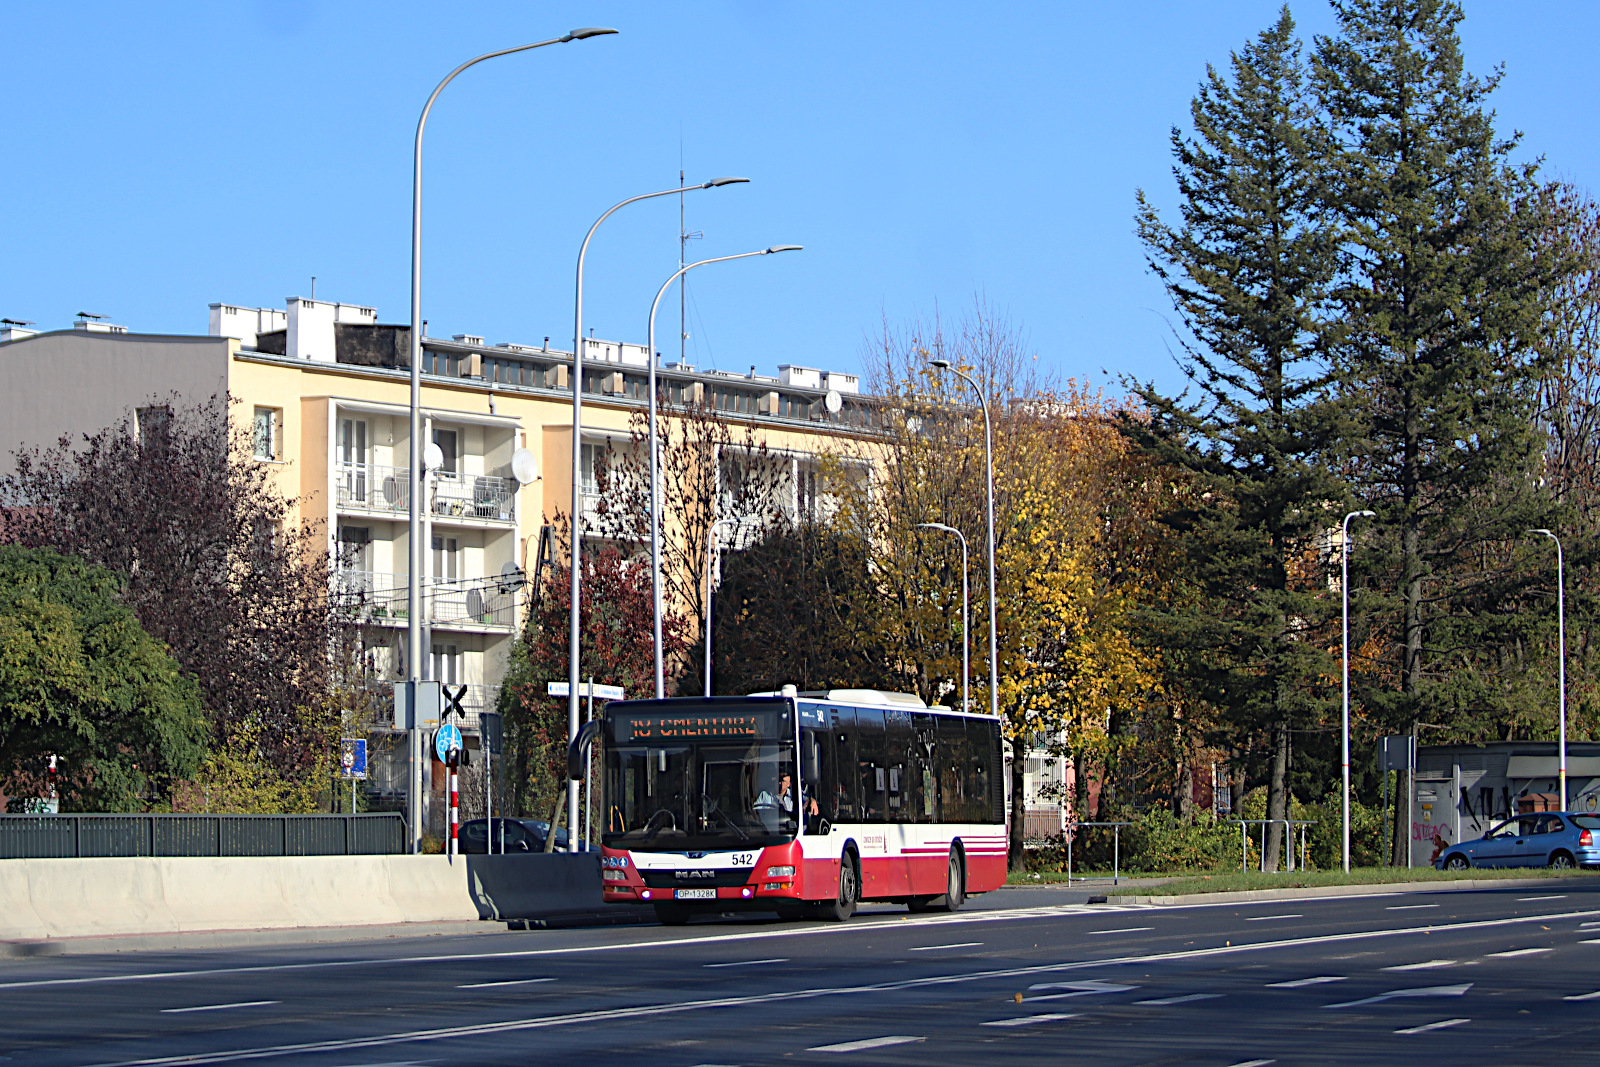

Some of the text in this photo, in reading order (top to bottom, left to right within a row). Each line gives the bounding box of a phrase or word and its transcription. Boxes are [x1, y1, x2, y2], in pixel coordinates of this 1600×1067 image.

[732, 854, 752, 865] 542
[675, 870, 715, 878] MAN
[679, 889, 714, 897] OP 1328K
